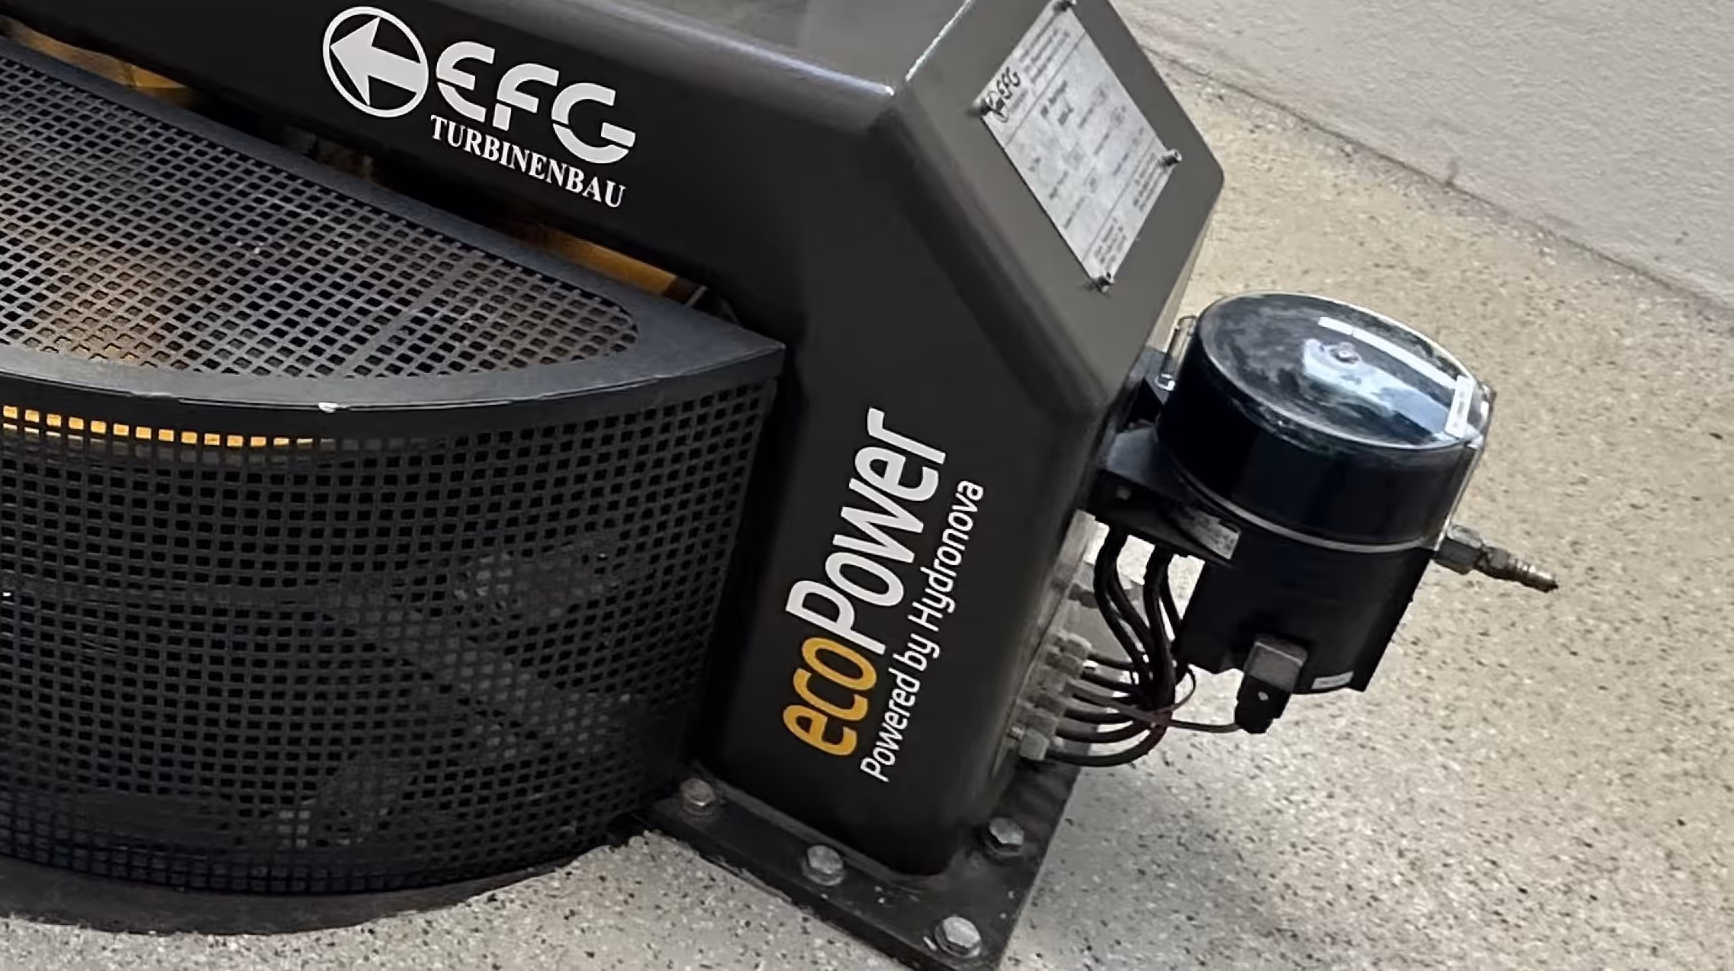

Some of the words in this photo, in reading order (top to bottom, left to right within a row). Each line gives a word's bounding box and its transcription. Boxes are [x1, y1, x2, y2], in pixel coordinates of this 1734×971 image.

[431, 114, 626, 208] TURBINENBAU
[436, 41, 636, 164] EFG
[782, 407, 946, 757] ecoPower
[907, 480, 985, 632] Hydronova
[893, 633, 940, 672] by
[860, 668, 921, 782] Powered
